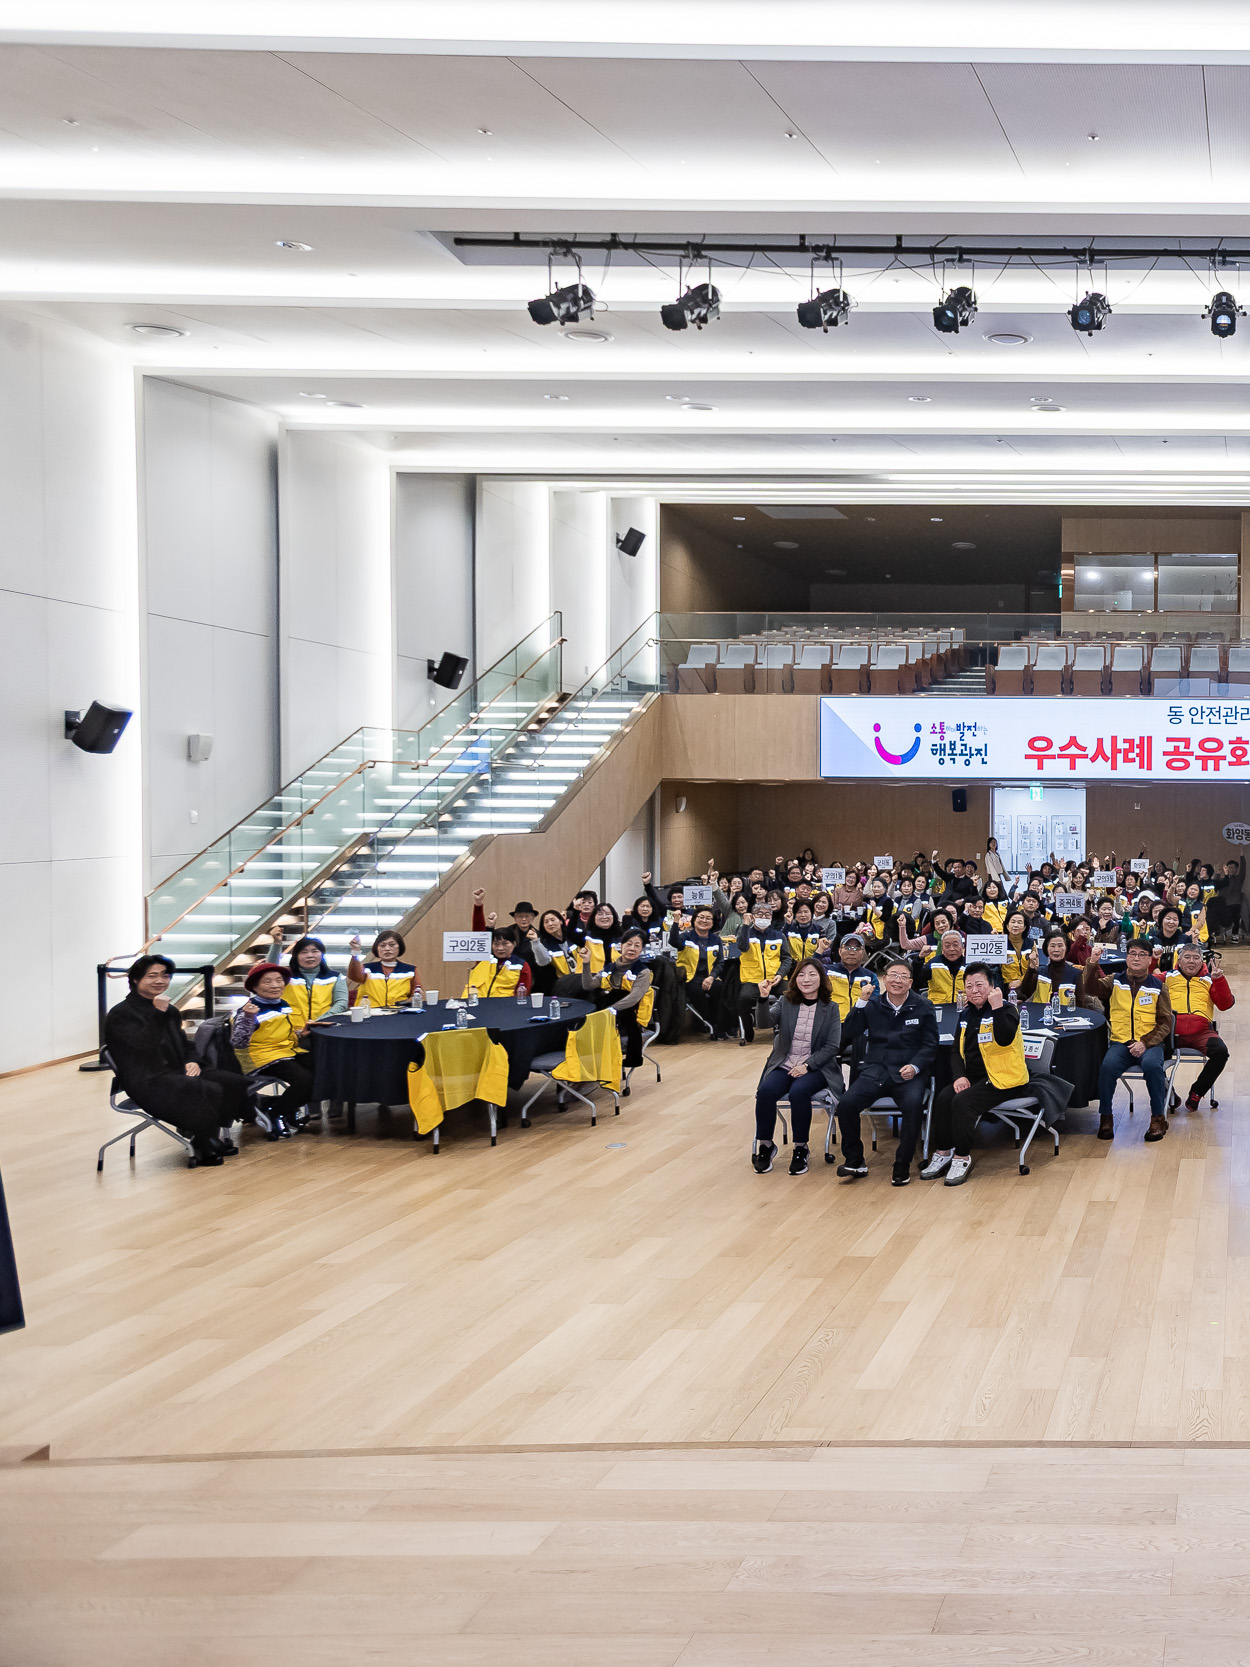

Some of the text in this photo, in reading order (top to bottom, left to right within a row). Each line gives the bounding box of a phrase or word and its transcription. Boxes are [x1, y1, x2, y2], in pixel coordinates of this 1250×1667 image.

[1167, 706, 1184, 725] 동
[930, 740, 988, 766] 행복광진
[1024, 735, 1152, 771] 우수사례
[691, 891, 705, 900] 능동
[1059, 898, 1082, 907] 중곡4동
[449, 940, 486, 952] 구의2동
[971, 942, 1003, 955] 구의2동
